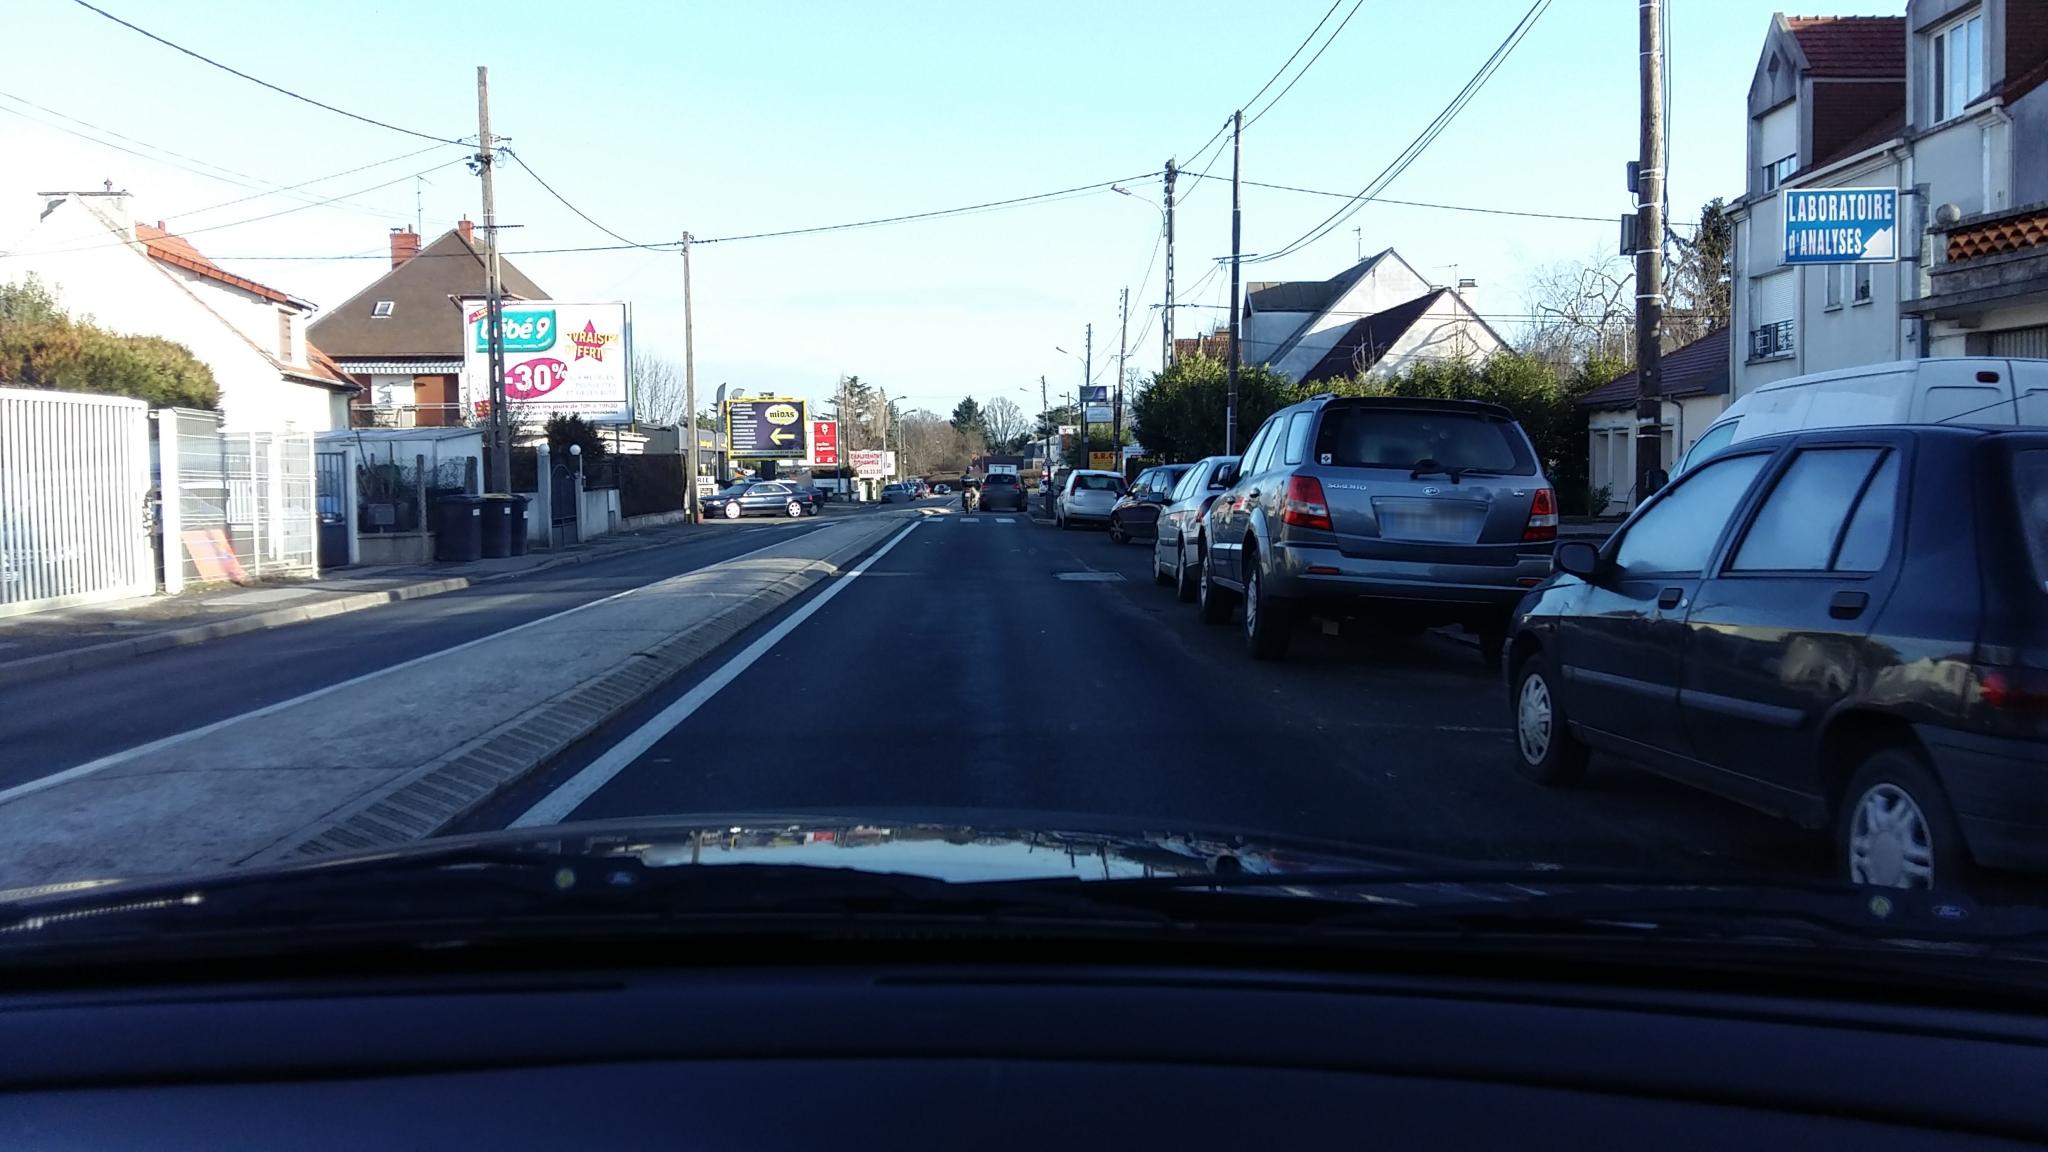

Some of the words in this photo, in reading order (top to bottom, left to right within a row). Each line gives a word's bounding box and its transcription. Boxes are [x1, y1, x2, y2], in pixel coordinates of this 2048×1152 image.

[1788, 193, 1892, 222] LABORATOIRE
[1788, 228, 1862, 256] d'ANALYSES
[535, 316, 551, 339] 9
[505, 363, 567, 392] -30%
